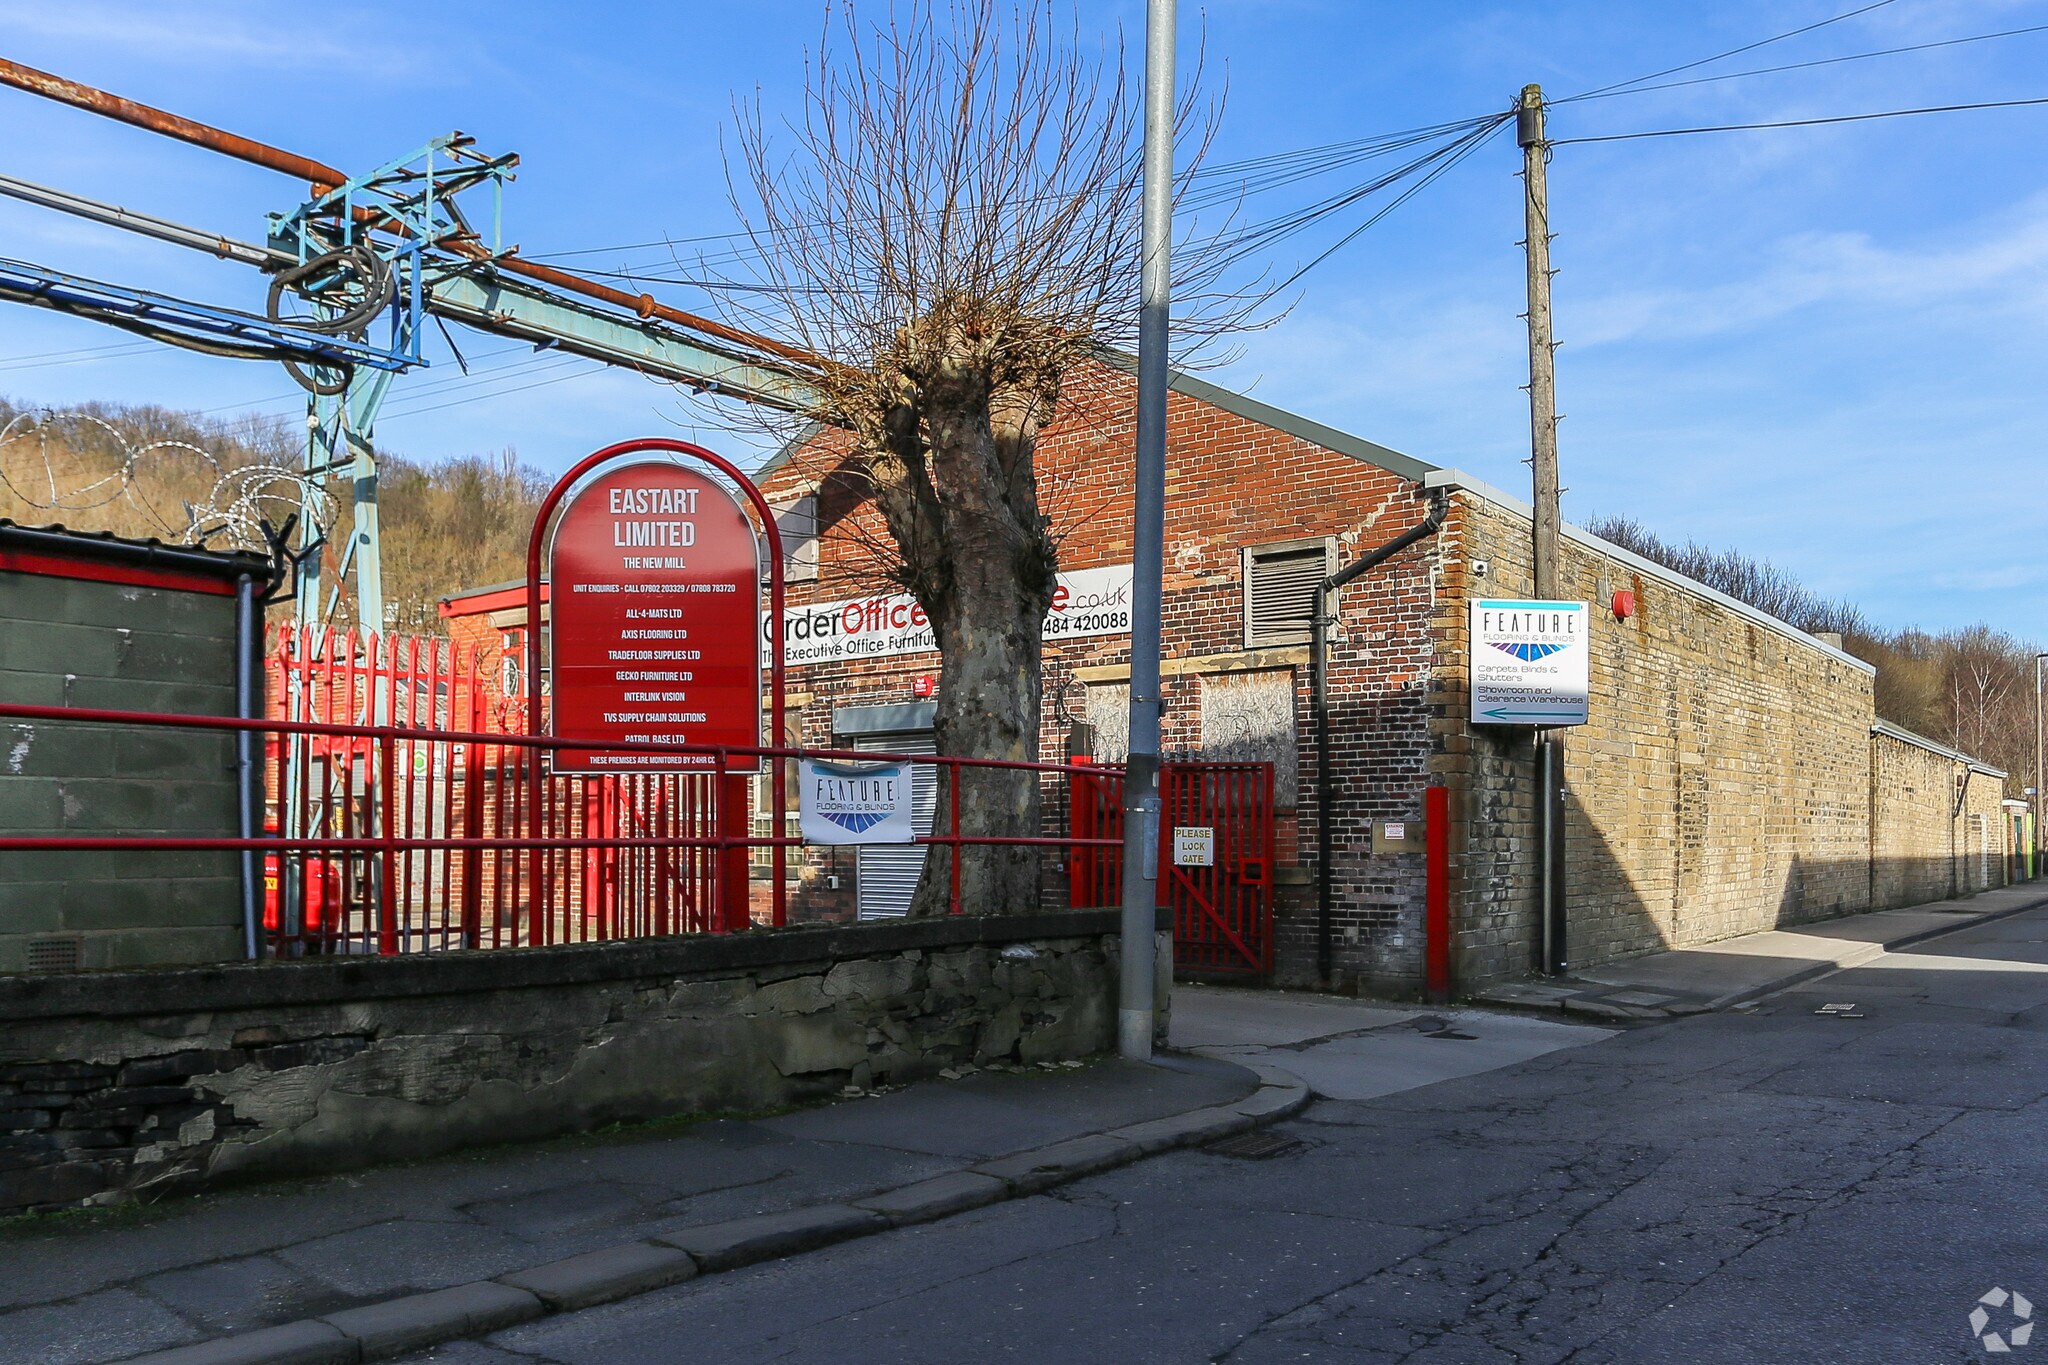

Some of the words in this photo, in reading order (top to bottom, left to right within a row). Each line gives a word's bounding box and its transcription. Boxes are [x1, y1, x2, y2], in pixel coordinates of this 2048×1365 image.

[609, 488, 700, 514] EASTART
[614, 521, 695, 547] LIMITED
[623, 557, 641, 569] THE
[642, 557, 663, 569] NEW
[664, 557, 686, 569] MILL
[573, 584, 588, 592] UNIT
[588, 584, 620, 592] ENQUIRIES
[624, 584, 640, 592] CALL
[712, 584, 736, 592] 783720
[626, 609, 668, 618] ALL-4-MATS
[669, 609, 682, 618] LTD
[621, 630, 638, 639] AXIS
[640, 630, 673, 639] FLOORING
[674, 630, 687, 639] LTD
[786, 643, 842, 661] Executive
[846, 639, 884, 654] Office
[889, 632, 935, 650] Furnitur
[1044, 618, 1069, 634] 484
[1074, 612, 1128, 632] 420088
[608, 650, 652, 660] TRADEFLOOR
[653, 650, 686, 660] SUPPLIES
[688, 650, 700, 660] LTD
[616, 672, 639, 680] GECKO
[640, 672, 678, 681] FURNITURE
[680, 672, 692, 681] LTD
[1478, 674, 1523, 682] Shutters
[1478, 686, 1532, 694] Showroom
[1534, 686, 1552, 694] and
[624, 692, 660, 702] INTERLINK
[662, 692, 686, 702] VISION
[1478, 694, 1526, 702] Clearance
[1528, 696, 1584, 704] Warehouse
[604, 713, 618, 722] TVS
[618, 713, 644, 722] SUPPLY
[646, 713, 668, 722] CHAIN
[668, 713, 706, 722] SOLUTIONS
[652, 735, 670, 744] BASE
[672, 735, 685, 744] LTD
[590, 756, 608, 764] THESE
[816, 802, 854, 810] FLOORING
[1176, 830, 1211, 838] PLEASE
[1182, 842, 1205, 850] LOCK
[1182, 854, 1204, 863] GATE
